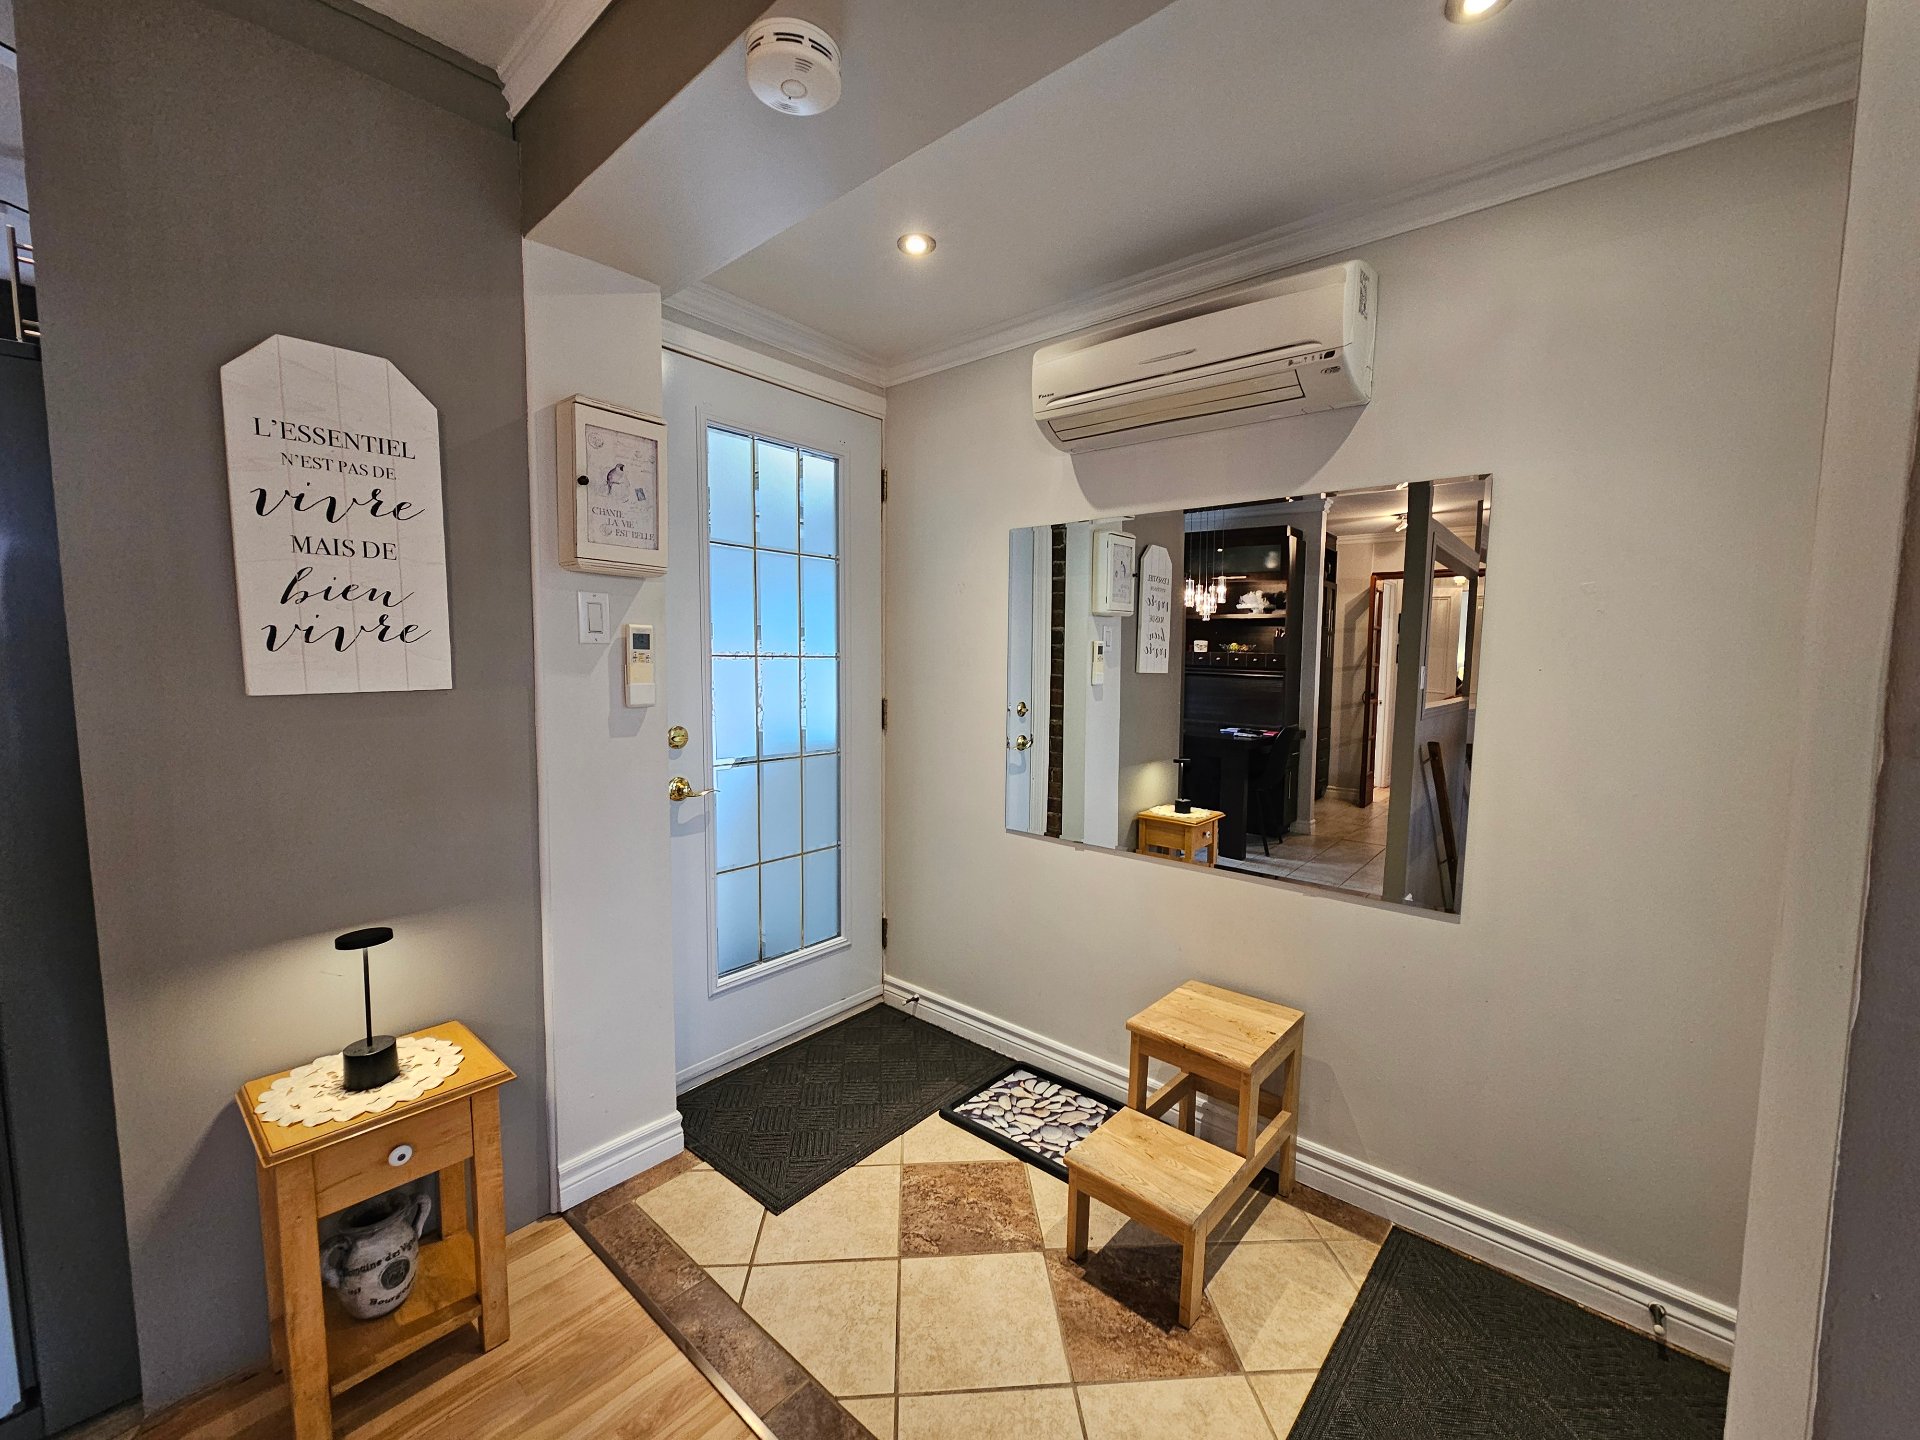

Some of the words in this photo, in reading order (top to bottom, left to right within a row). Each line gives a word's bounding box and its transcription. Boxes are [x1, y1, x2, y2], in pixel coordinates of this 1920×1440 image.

[254, 416, 416, 460] L'ESSENTIEL
[281, 452, 334, 471] N'EST
[338, 461, 369, 477] PAS
[372, 465, 397, 480] DE
[250, 482, 425, 524] vivre
[290, 534, 356, 558] MAIS
[362, 540, 398, 561] DE
[280, 566, 415, 607] bien
[261, 613, 431, 653] vivre
